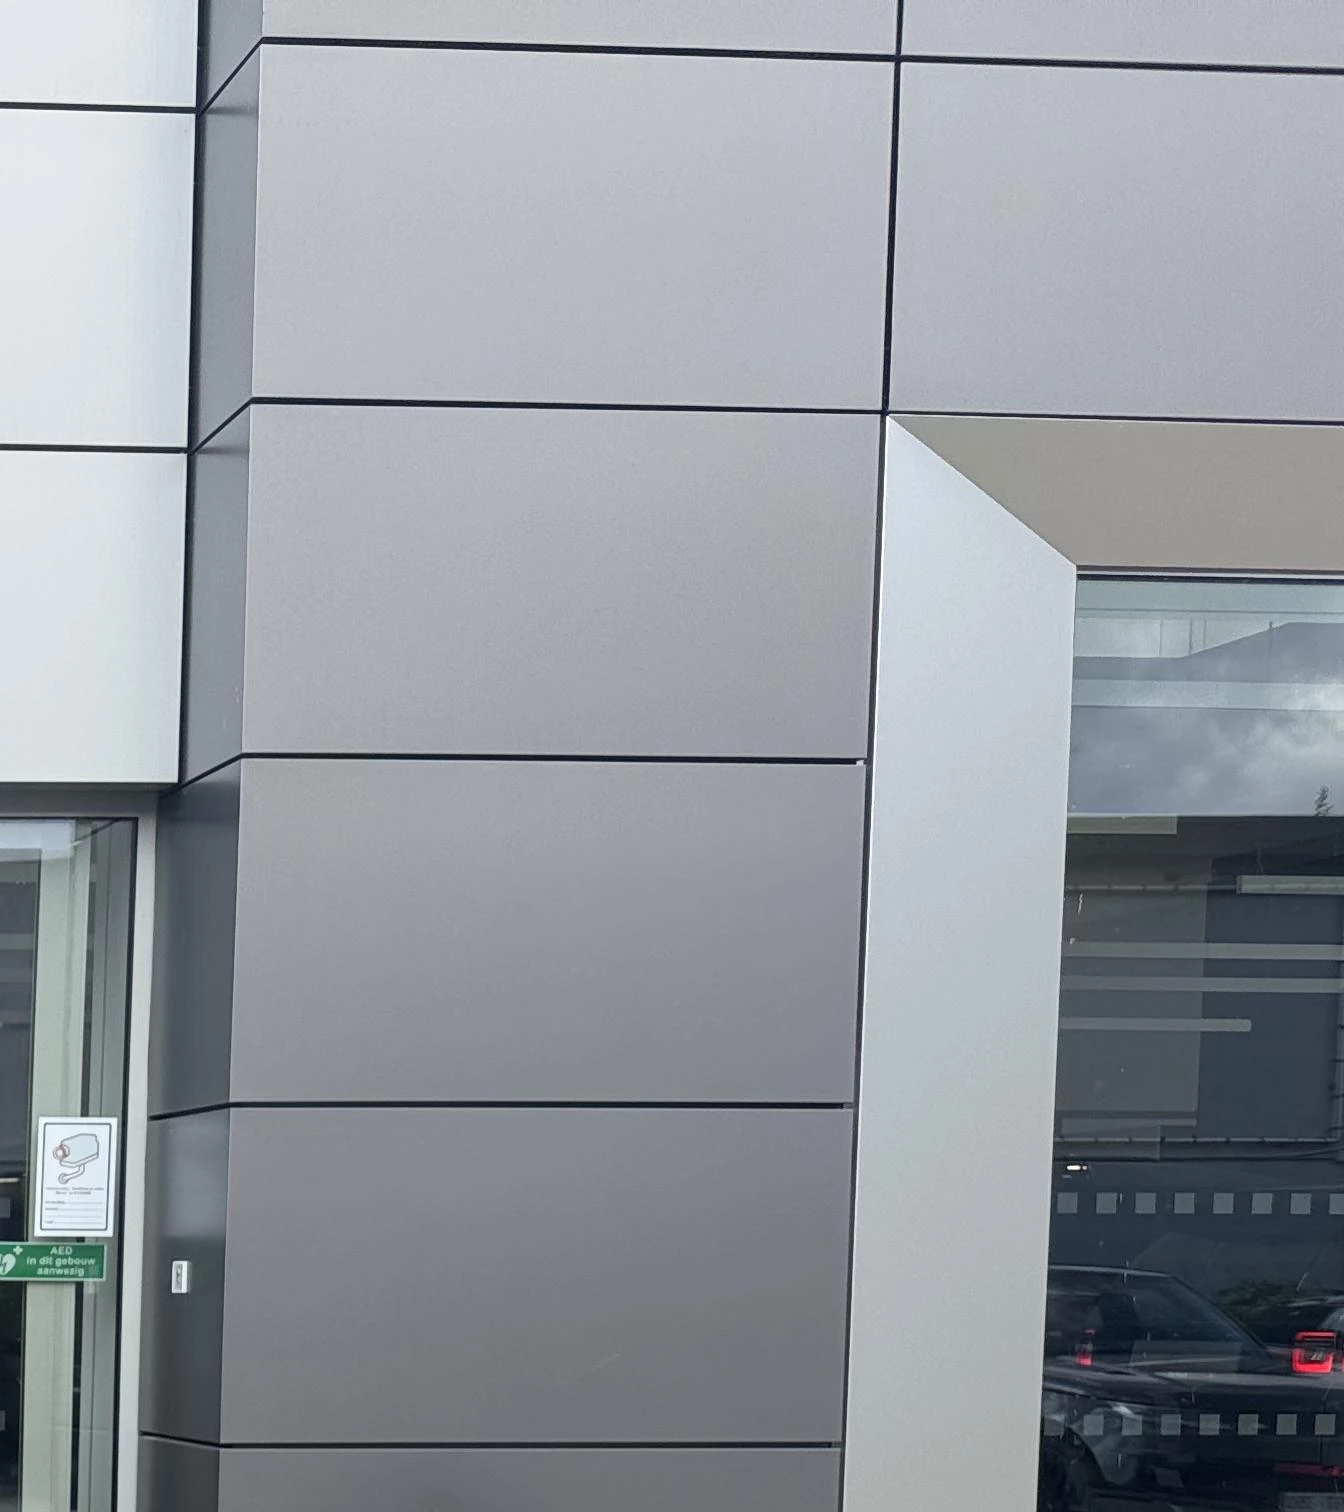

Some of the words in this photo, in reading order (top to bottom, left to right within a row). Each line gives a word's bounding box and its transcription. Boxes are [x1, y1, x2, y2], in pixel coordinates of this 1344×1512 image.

[49, 1246, 73, 1255] AED
[26, 1257, 37, 1265] in
[38, 1256, 54, 1265] dit
[55, 1256, 96, 1267] gebouw
[36, 1266, 85, 1276] aanwezig
